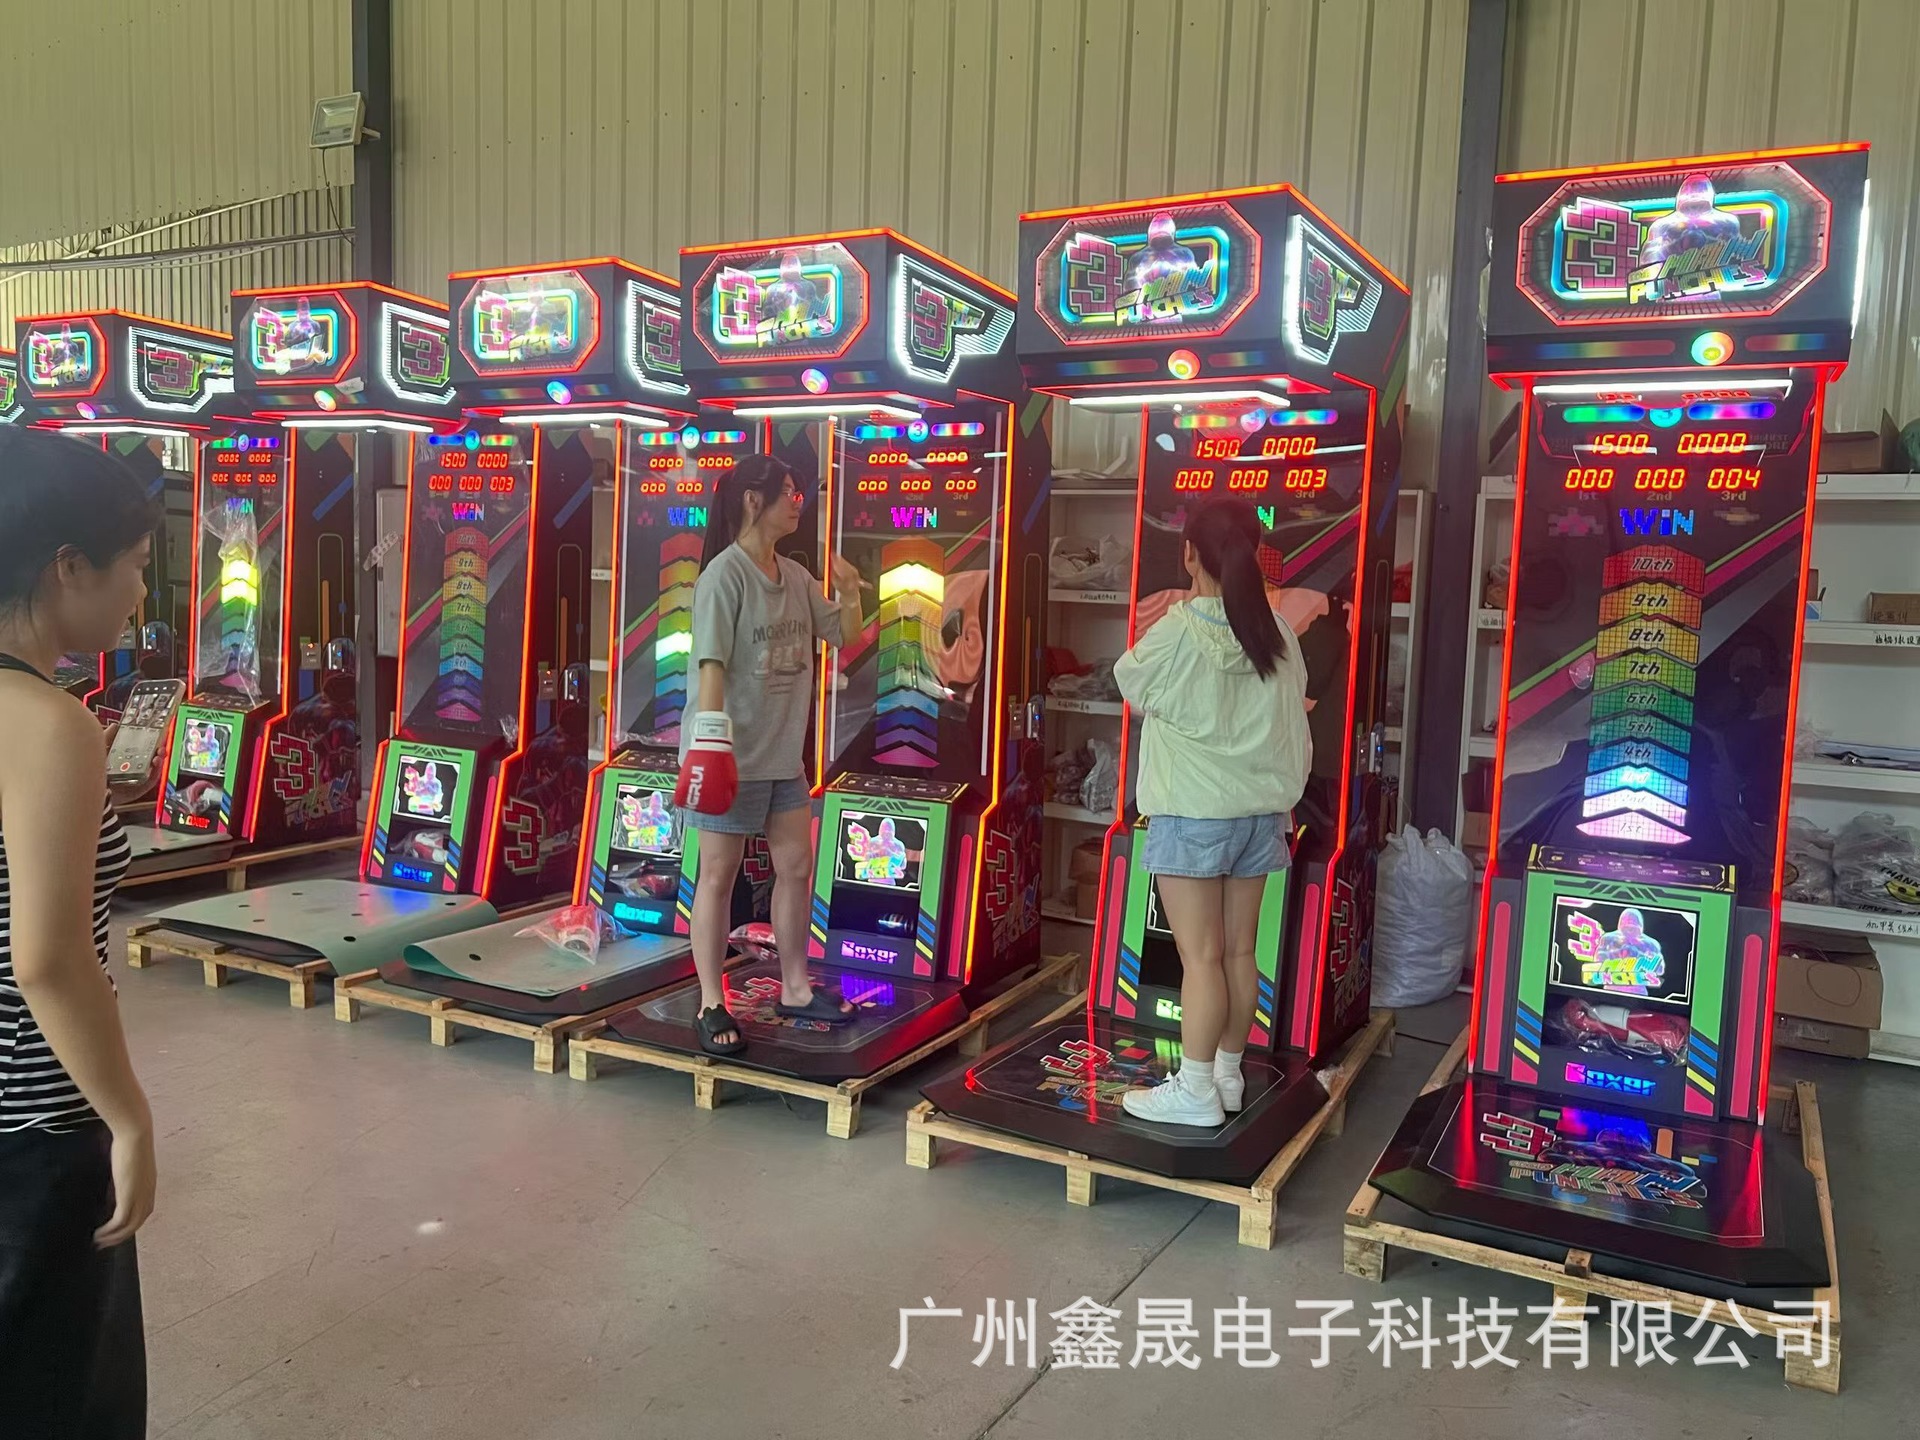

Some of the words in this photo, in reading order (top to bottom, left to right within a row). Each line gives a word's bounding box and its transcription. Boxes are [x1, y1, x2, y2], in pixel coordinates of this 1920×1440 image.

[1561, 196, 1641, 292] 3
[1065, 232, 1123, 315] 3
[716, 266, 763, 337] 3
[476, 290, 513, 352] 3
[915, 285, 948, 351] 3
[402, 328, 447, 378] 3
[149, 347, 194, 390] 3
[1197, 439, 1241, 458] 1500
[1263, 437, 1316, 457] 0000
[1592, 433, 1650, 455] 1500
[1677, 432, 1747, 454] 0000
[441, 452, 467, 468] 1500
[477, 453, 508, 468] 0000
[429, 475, 452, 490] 000
[459, 476, 482, 490] 000
[490, 476, 514, 491] 003
[1175, 470, 1214, 489] 000
[1229, 470, 1269, 489] 000
[1285, 469, 1327, 488] 003
[1565, 468, 1614, 489] 000
[1634, 468, 1685, 489] 000
[1707, 468, 1761, 489] 004
[1295, 490, 1315, 499] 3rd
[1646, 491, 1673, 501] 2nd
[1720, 490, 1747, 501] 3rd
[1631, 558, 1675, 571] 10th
[456, 581, 473, 590] 8th
[456, 602, 471, 612] 7th
[1631, 593, 1668, 607] 9th
[1628, 628, 1665, 642] 8th
[1628, 661, 1660, 675] 7th
[1626, 692, 1658, 705] 6th
[1626, 721, 1654, 733] 5th
[1624, 747, 1651, 758] 4th
[270, 733, 316, 800] 3
[503, 798, 545, 873] 3
[1620, 822, 1642, 833] 1st
[847, 821, 870, 862] 3
[985, 829, 1016, 921] 3
[1567, 911, 1603, 962] 3
[842, 940, 898, 964] Boxer
[1480, 1112, 1557, 1160] 3
